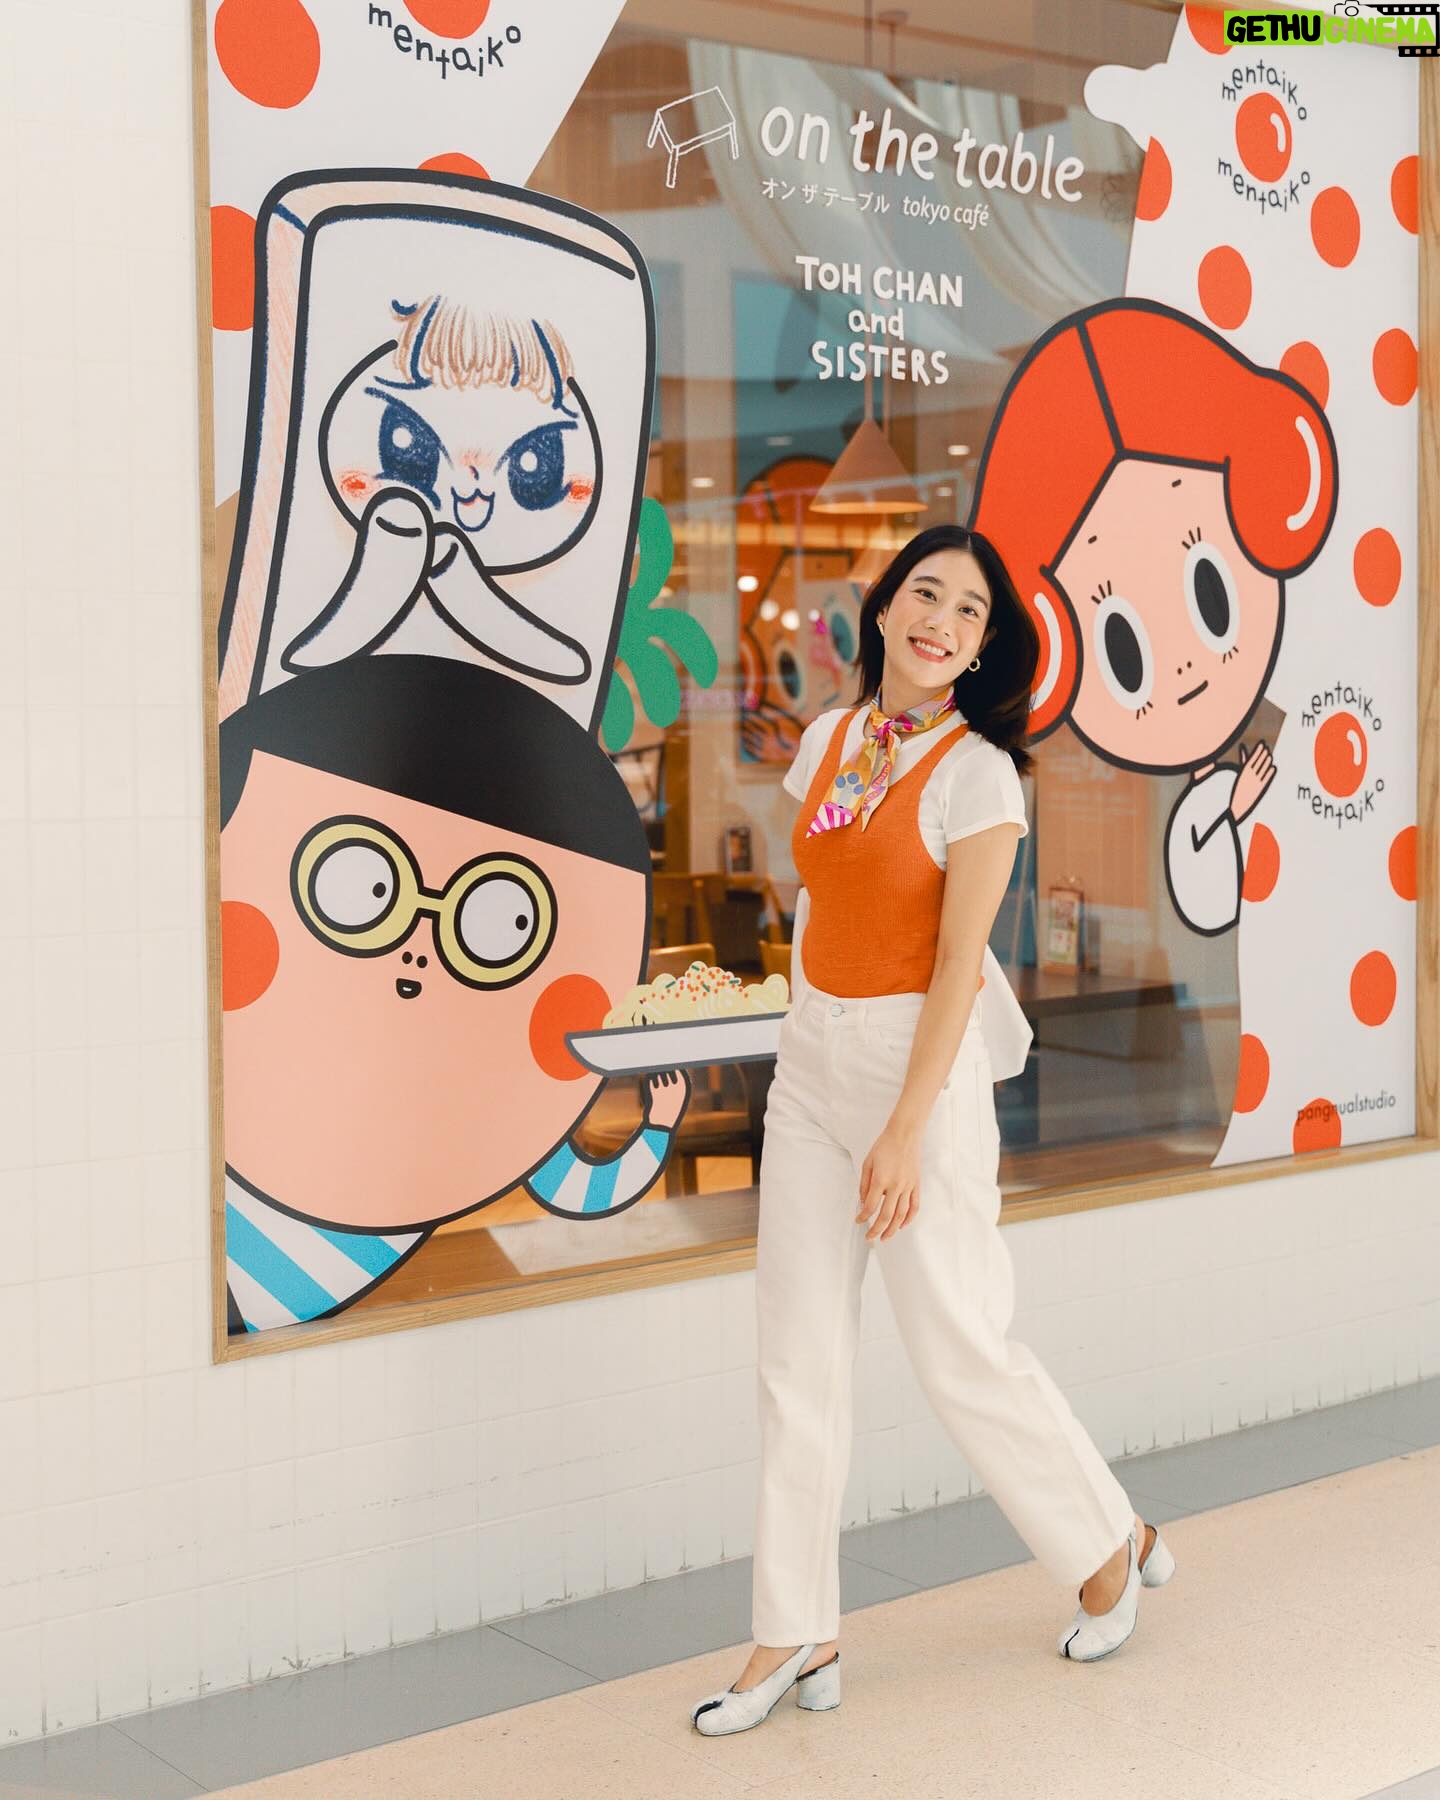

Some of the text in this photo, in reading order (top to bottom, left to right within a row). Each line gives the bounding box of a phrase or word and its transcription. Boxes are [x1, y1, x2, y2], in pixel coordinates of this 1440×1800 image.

[368, 3, 521, 79] mentaiko
[1222, 59, 1307, 121] mentaiko
[761, 106, 1085, 202] on the table
[1218, 157, 1310, 215] mentaiko
[903, 195, 990, 231] tokyo café
[795, 255, 964, 308] TOH CHAN
[848, 308, 904, 340] and
[811, 341, 950, 386] SISTERS
[1301, 681, 1383, 733] mentaiko
[1297, 777, 1385, 829] mentaiko
